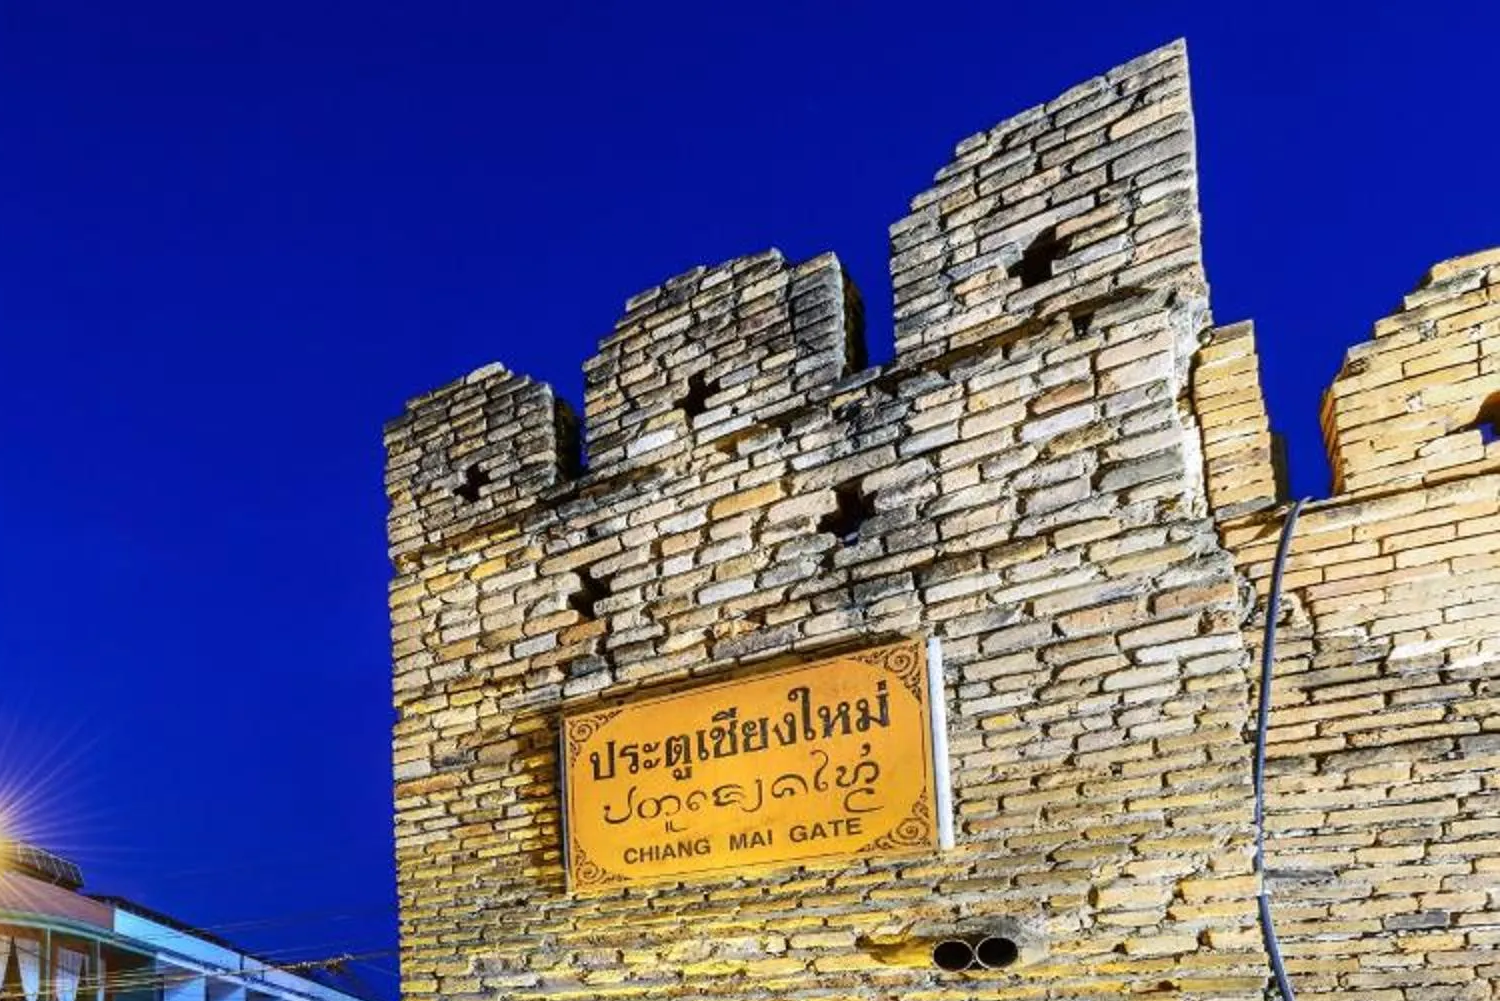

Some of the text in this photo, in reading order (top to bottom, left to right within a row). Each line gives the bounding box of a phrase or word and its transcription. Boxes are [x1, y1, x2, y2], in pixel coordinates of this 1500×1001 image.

[589, 679, 891, 781] ประตูเชียงใหม่
[623, 817, 863, 865] CHIANG MAI GATE
